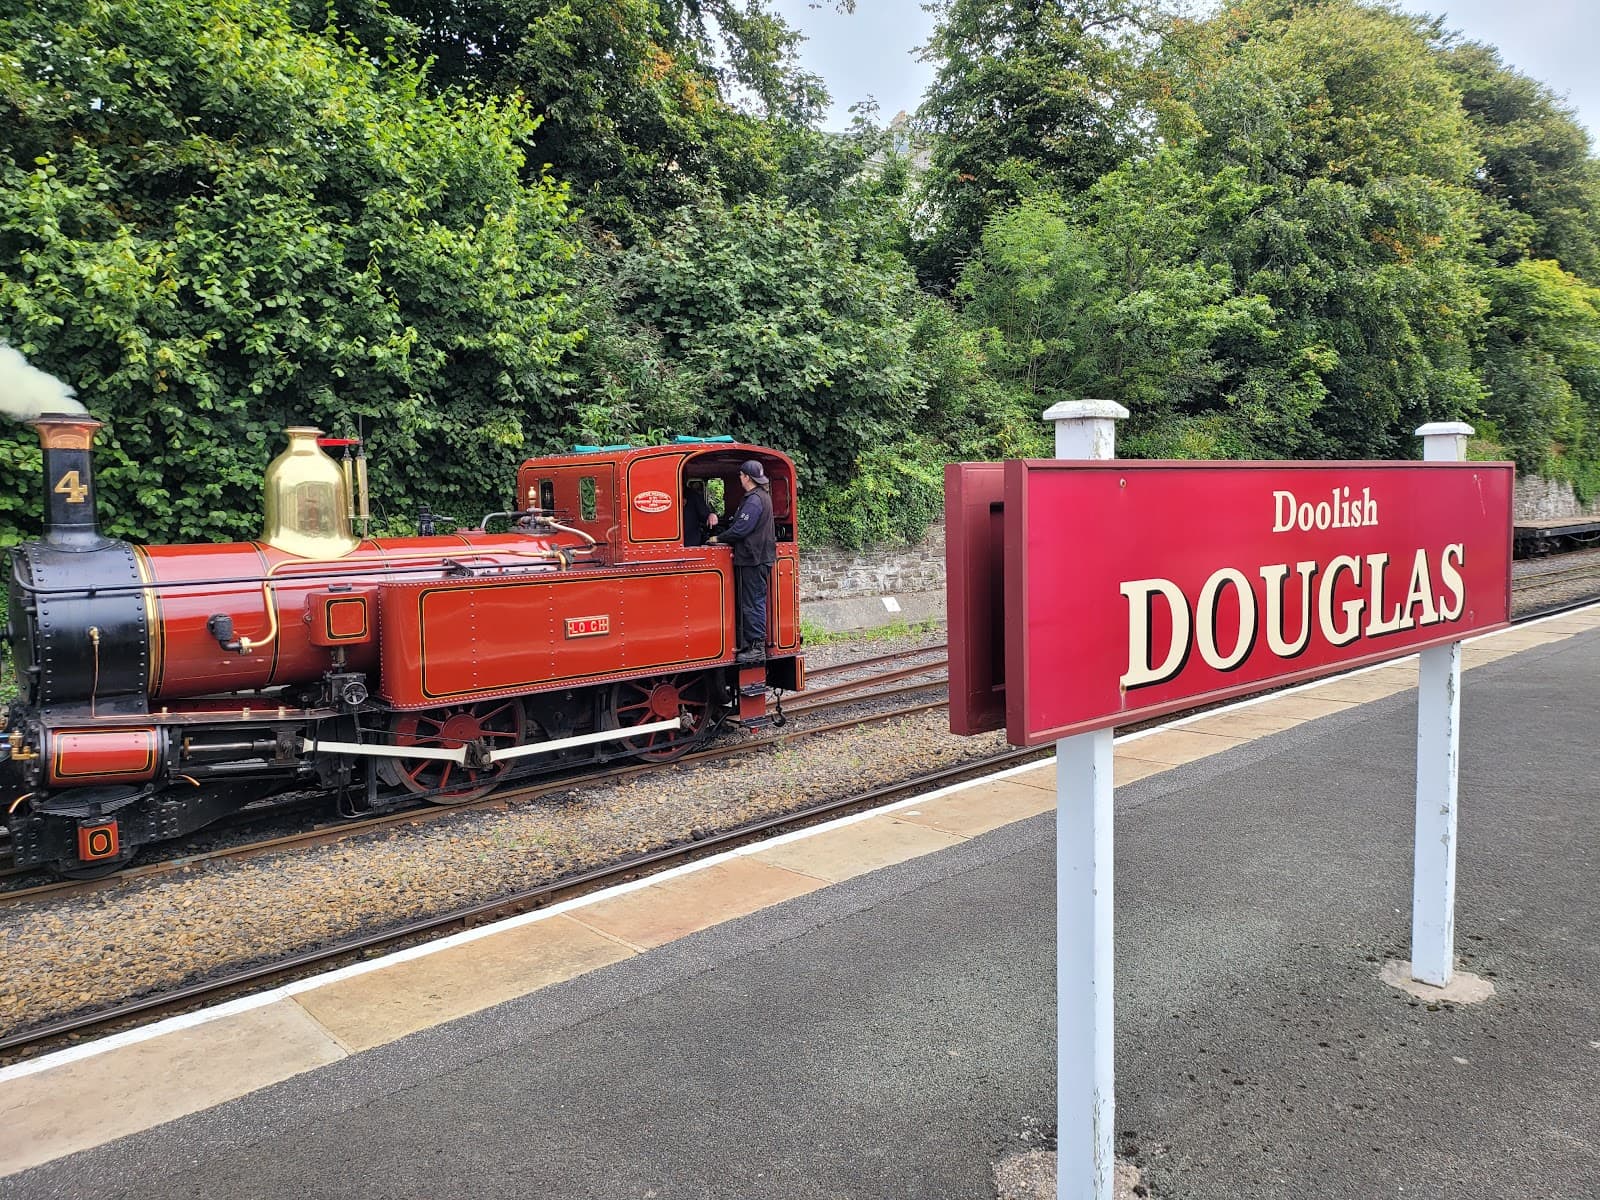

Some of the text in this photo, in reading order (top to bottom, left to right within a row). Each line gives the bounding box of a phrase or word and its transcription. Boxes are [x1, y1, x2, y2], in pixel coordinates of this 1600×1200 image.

[54, 470, 88, 502] 4
[1272, 486, 1379, 532] Doolish
[1119, 543, 1465, 689] DOUGLAS
